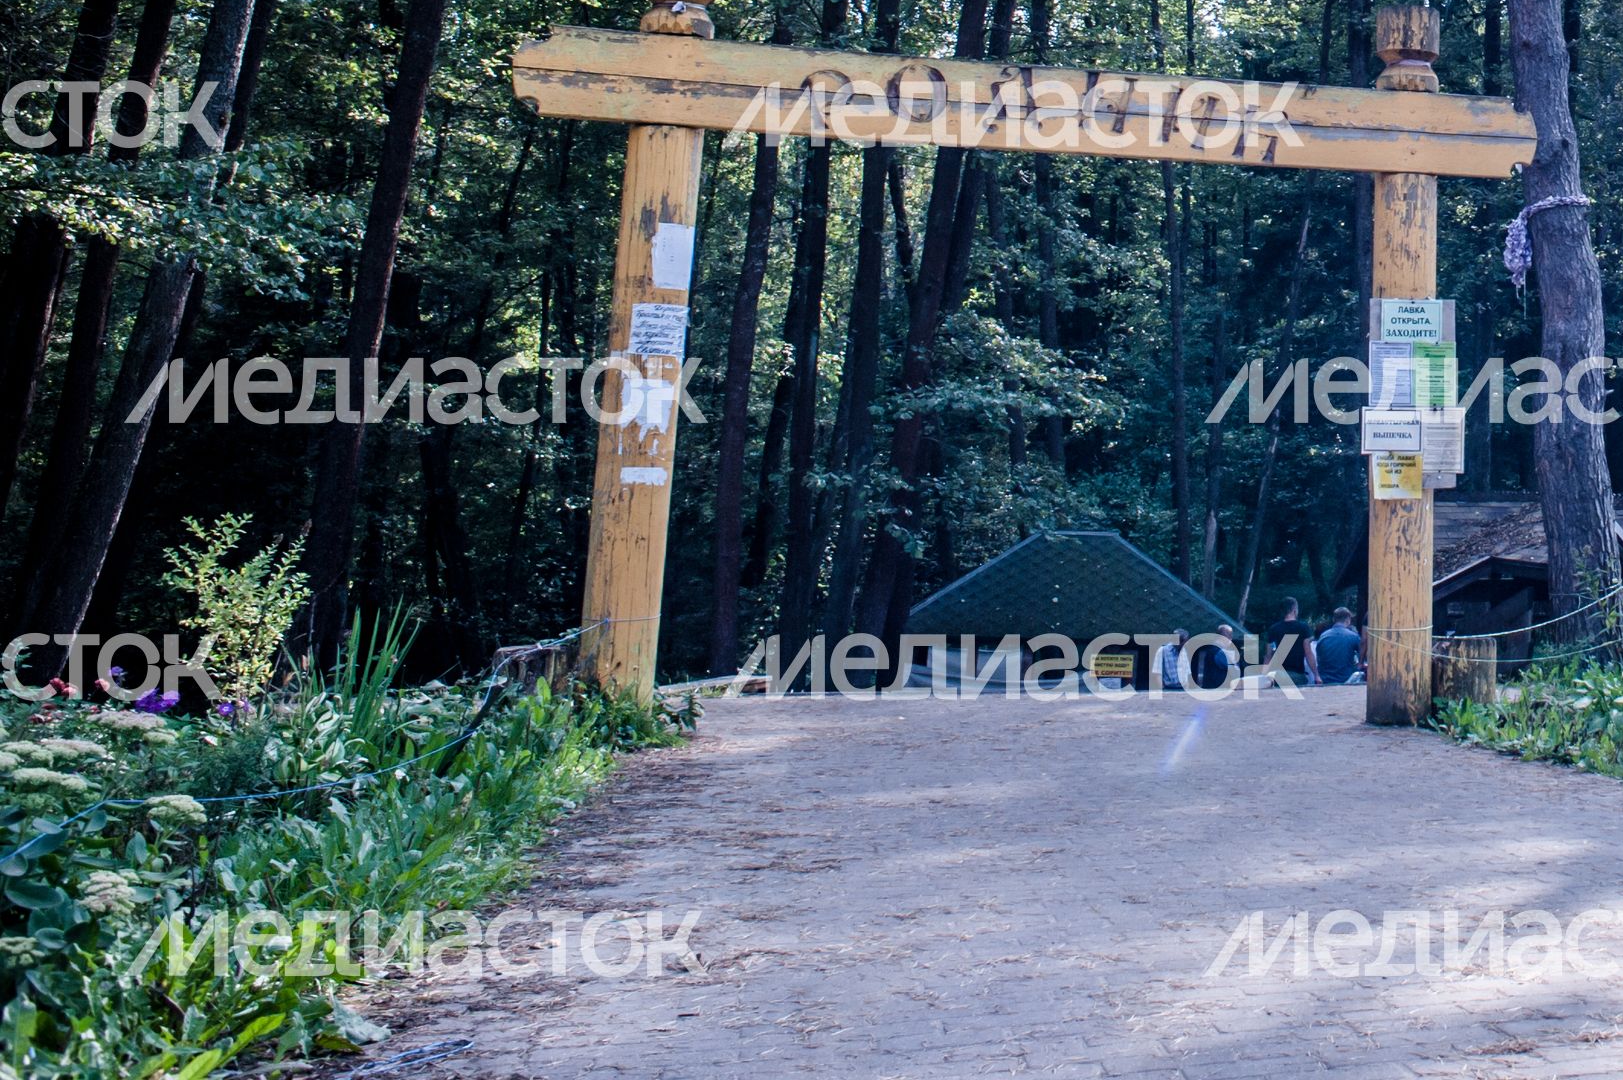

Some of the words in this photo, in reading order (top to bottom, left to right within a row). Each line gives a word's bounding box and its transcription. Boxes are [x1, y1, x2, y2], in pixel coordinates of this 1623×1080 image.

[1398, 306, 1426, 314] ЛАВКА
[1390, 316, 1433, 325] ОТКРЫТА.
[1385, 328, 1437, 338] ЗАХОДИТЕ!
